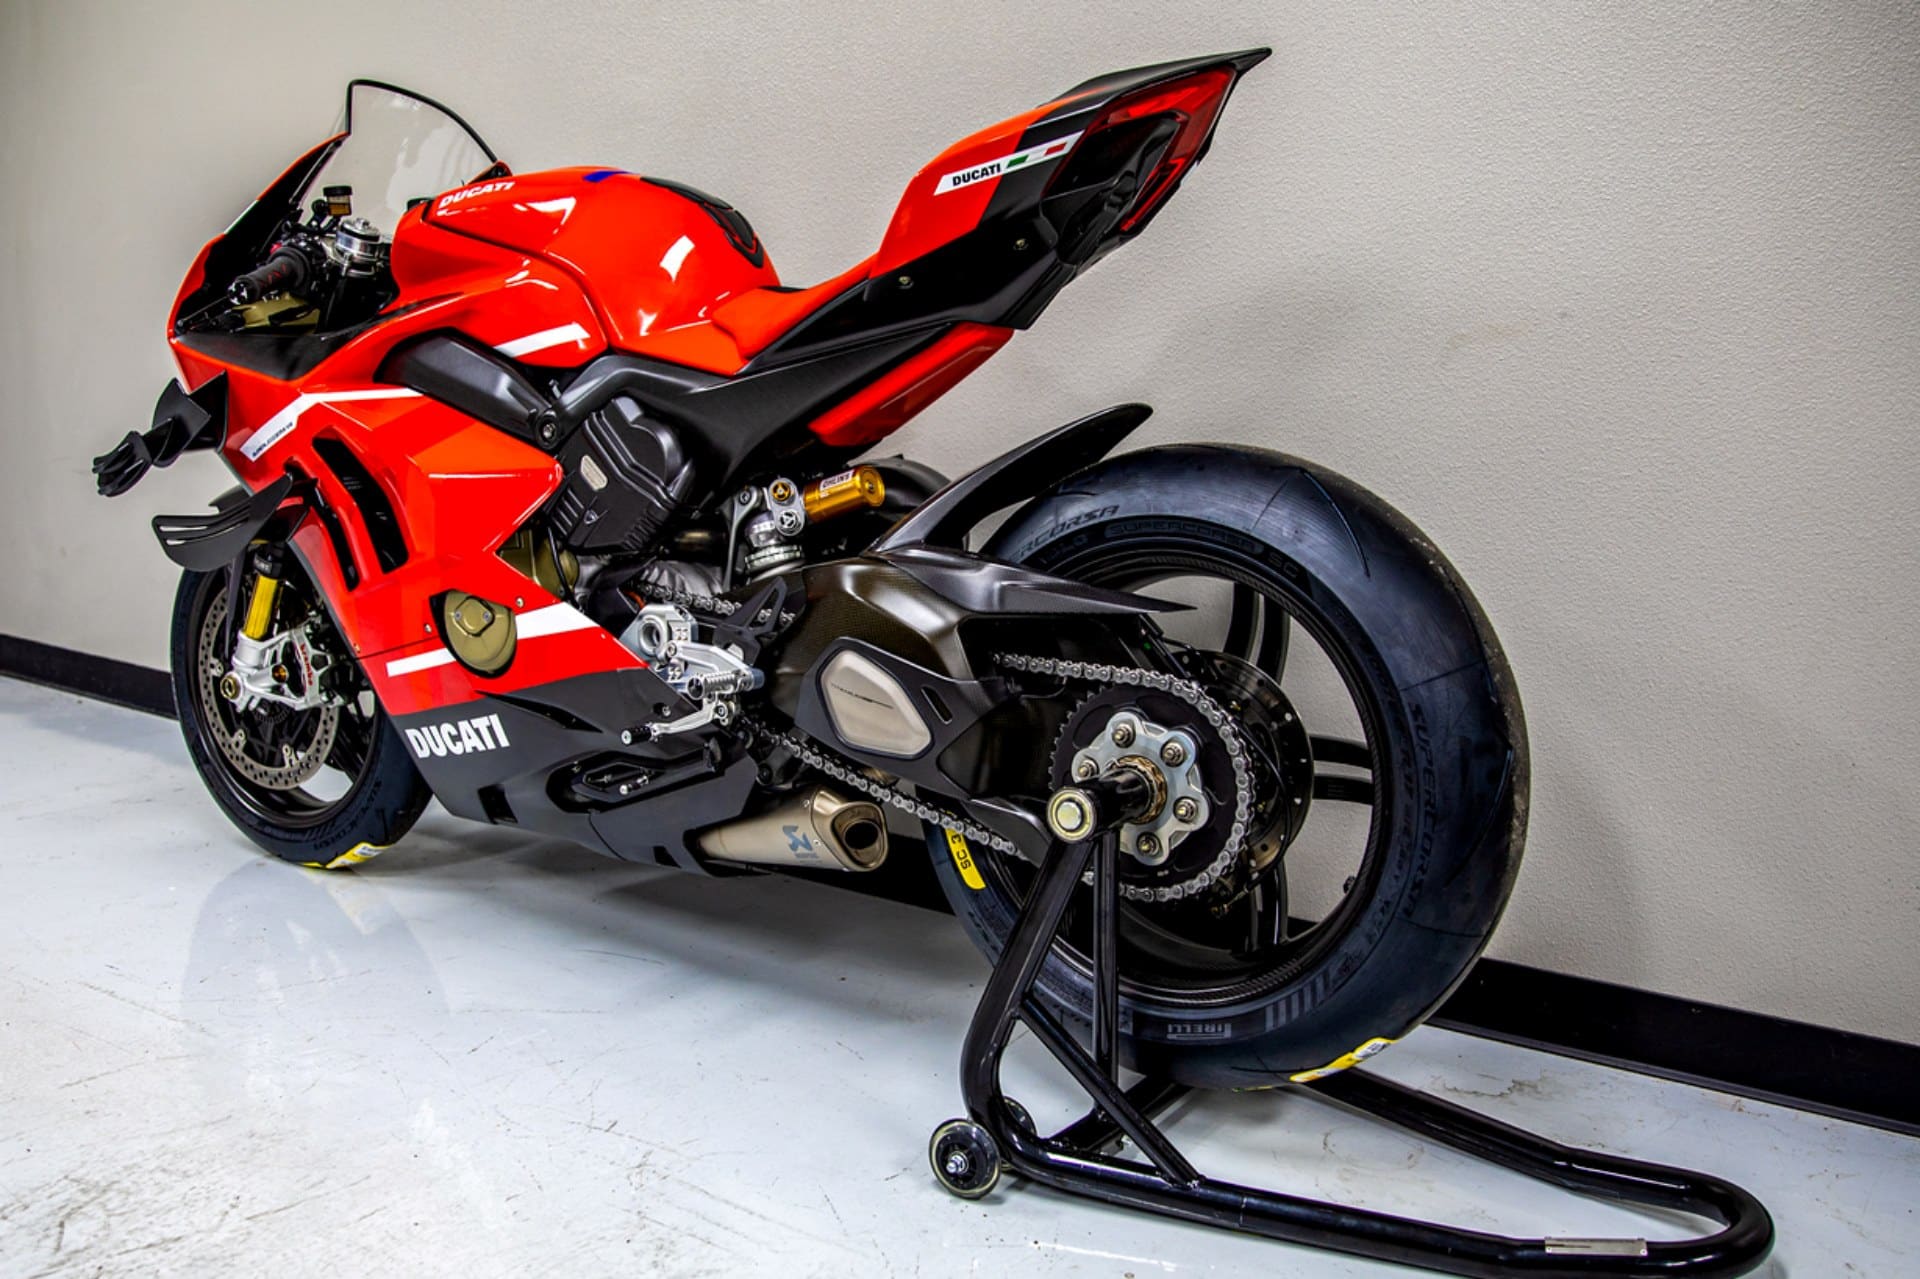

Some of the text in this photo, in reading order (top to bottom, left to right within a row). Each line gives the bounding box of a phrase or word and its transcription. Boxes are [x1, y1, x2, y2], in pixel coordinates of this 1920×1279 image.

[953, 163, 1001, 187] DUCATI
[439, 181, 516, 209] DUCATI
[404, 713, 509, 759] DUCATI
[956, 849, 972, 870] SC
[1166, 1023, 1232, 1040] PIRELLI
